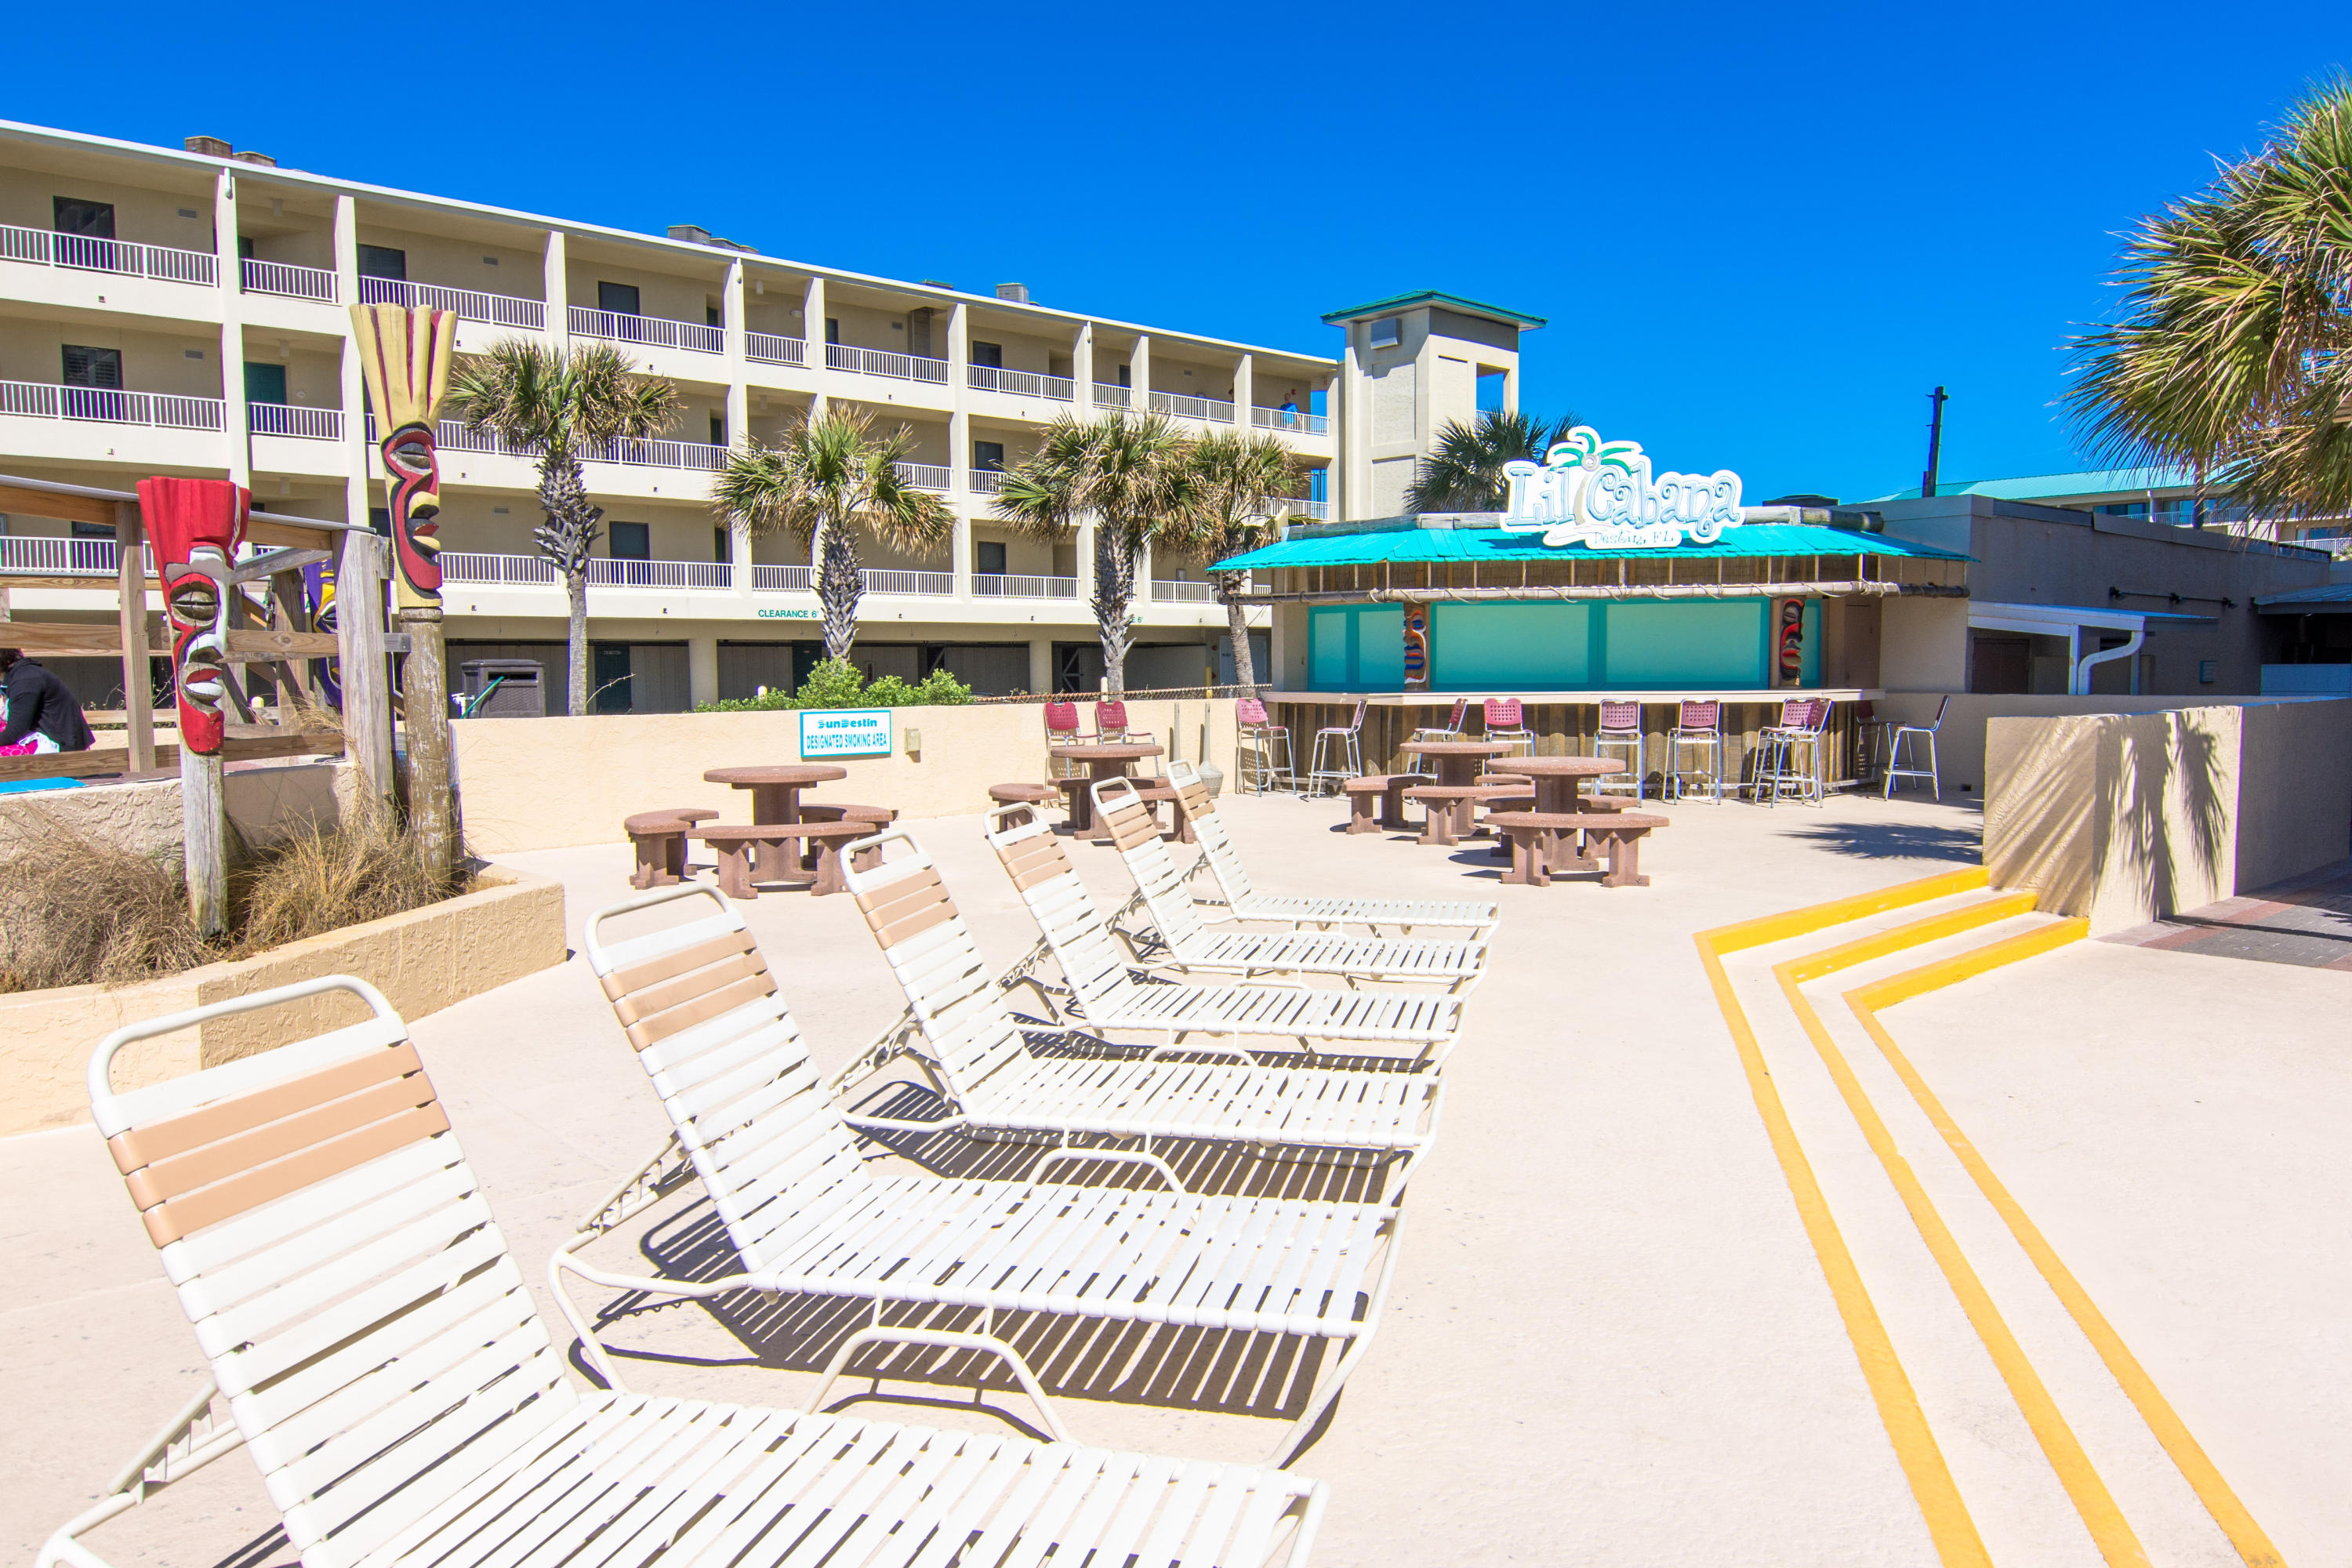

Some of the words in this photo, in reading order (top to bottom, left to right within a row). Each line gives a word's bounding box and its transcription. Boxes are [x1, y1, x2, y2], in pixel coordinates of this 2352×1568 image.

[1505, 467, 1576, 526] Lil
[1587, 461, 1740, 537] Cabana
[758, 609, 808, 618] CLEARANCE
[818, 718, 877, 729] SunDestin
[807, 734, 843, 750] DESIGNATED
[844, 733, 870, 748] SMOKING
[873, 732, 887, 746] AREA
